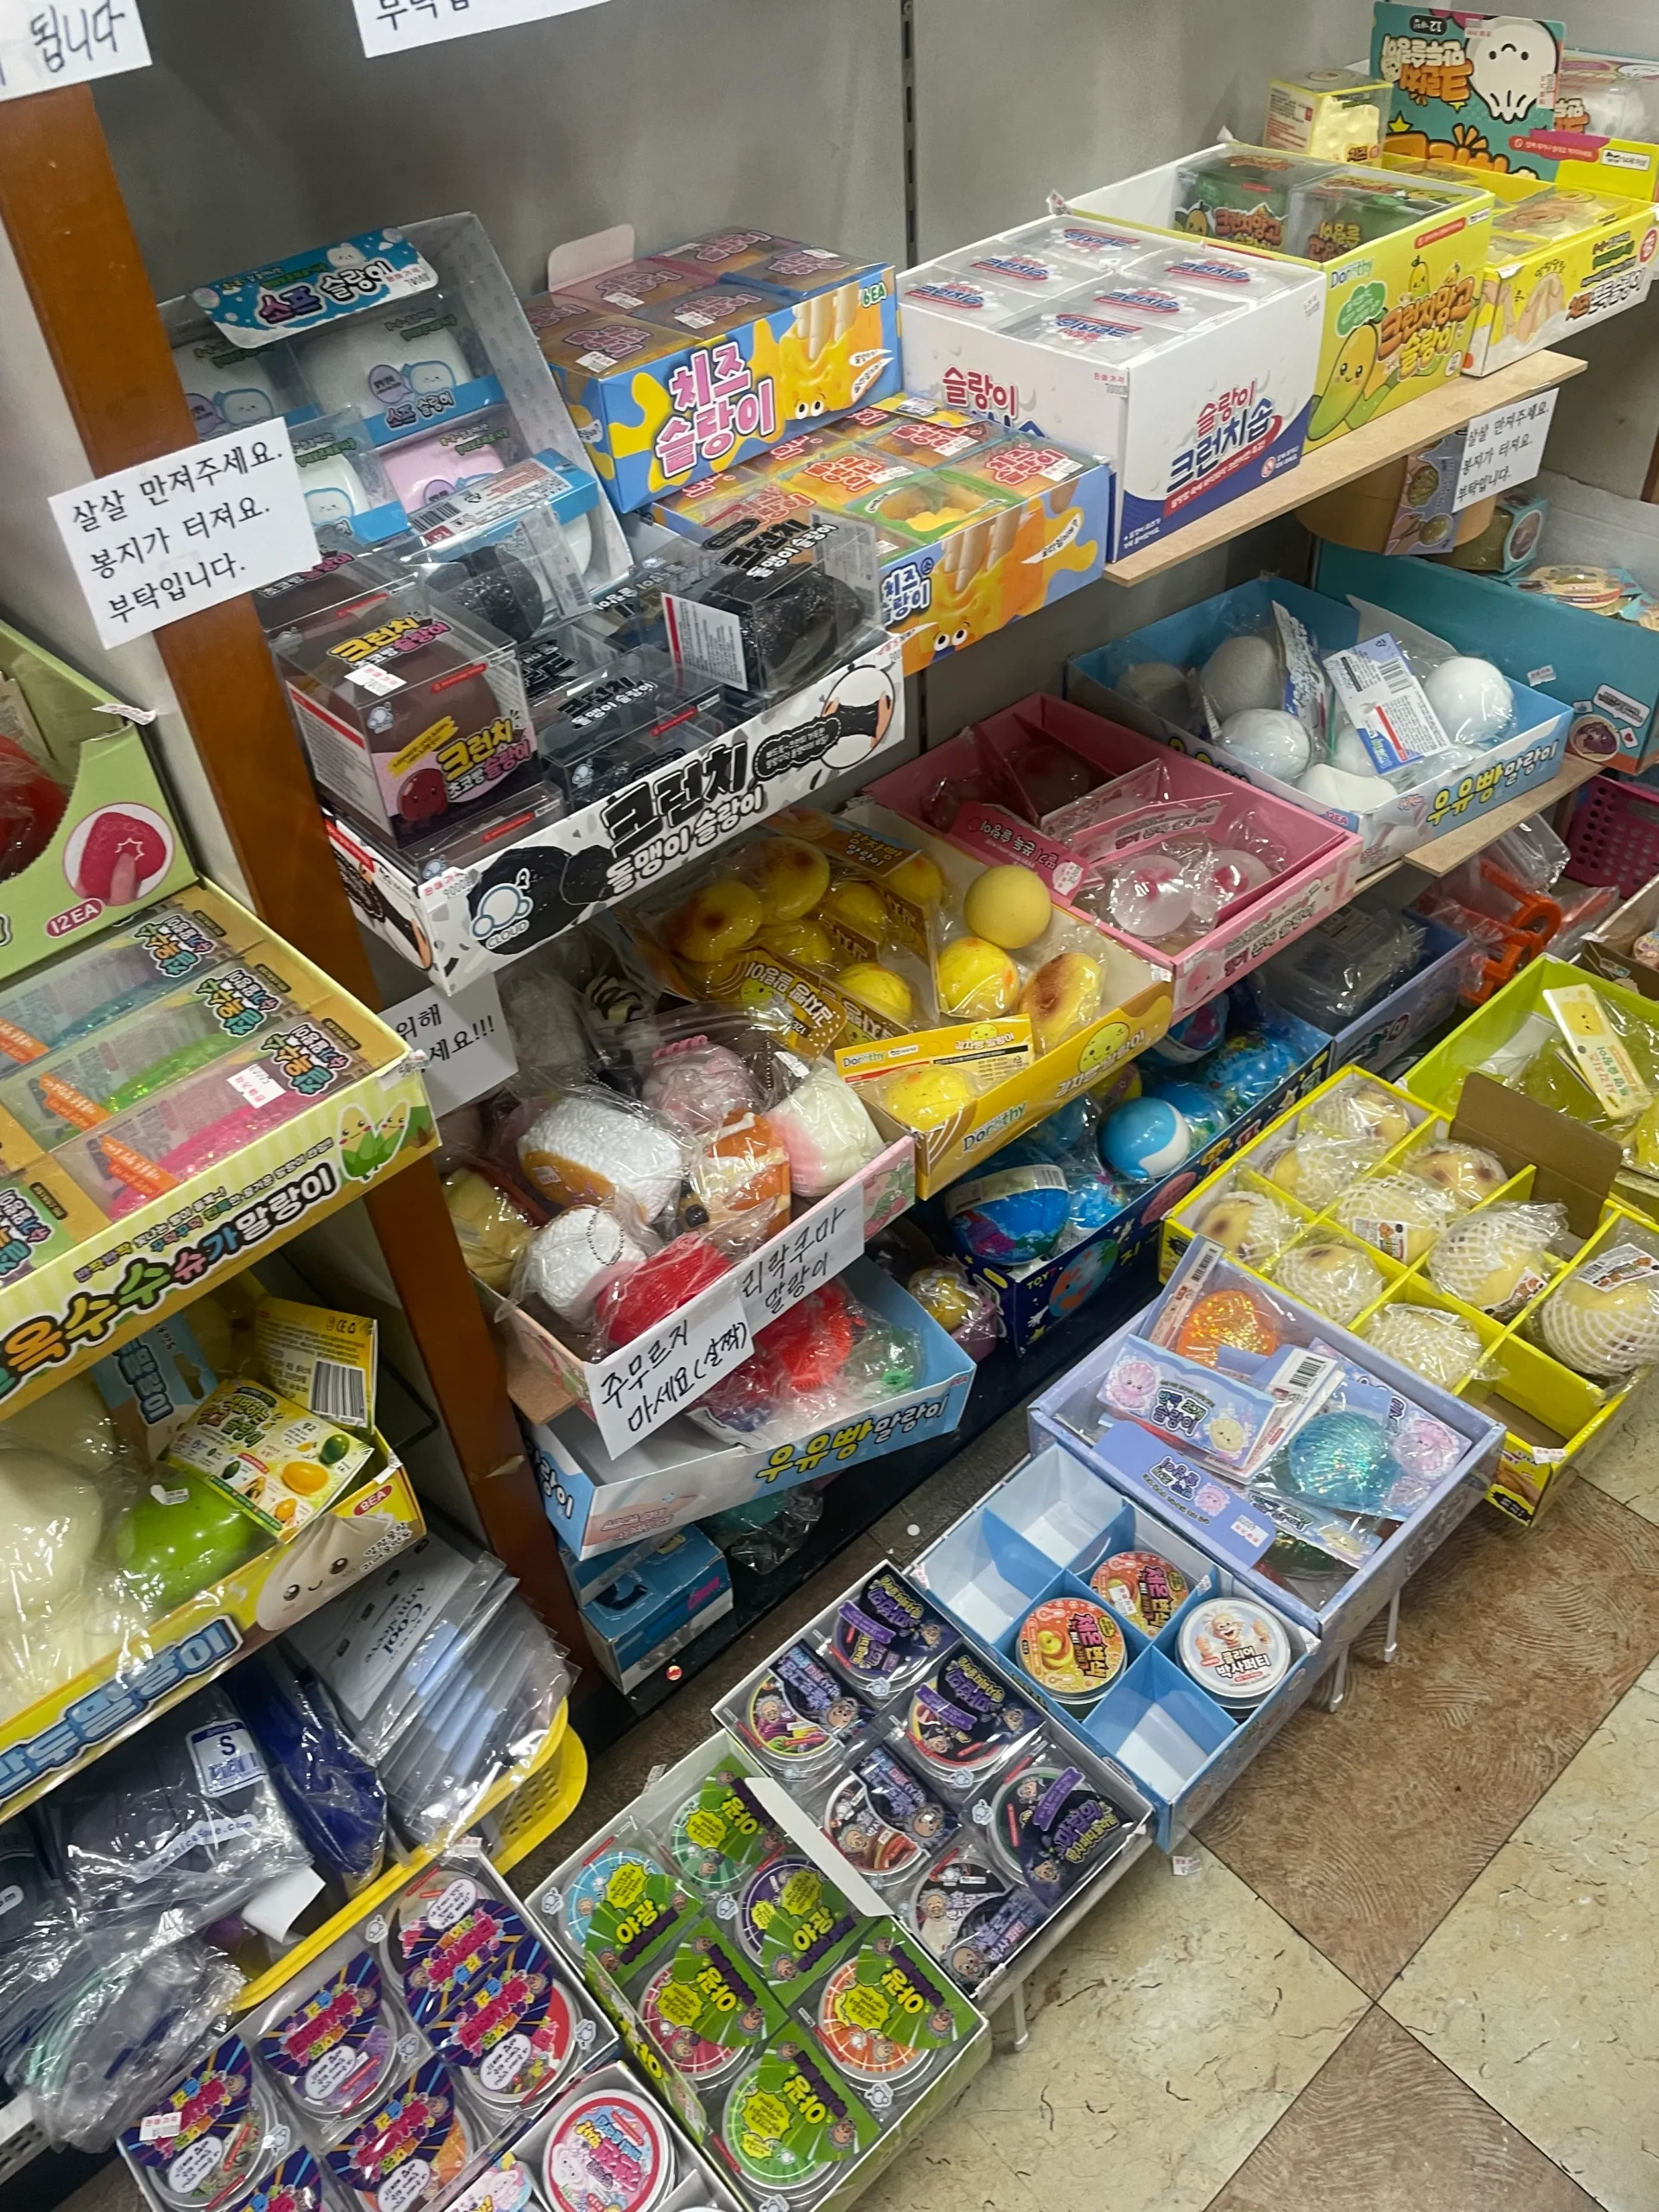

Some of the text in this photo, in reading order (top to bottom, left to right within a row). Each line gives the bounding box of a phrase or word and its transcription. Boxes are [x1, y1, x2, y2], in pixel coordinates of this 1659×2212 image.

[30, 1, 125, 73] 됩니다
[259, 282, 325, 324] 소프
[321, 257, 391, 300] 슬랑이
[1378, 276, 1476, 361] 크런치망고
[669, 341, 750, 410] 치즈
[1399, 325, 1455, 380] 슬랑이
[943, 365, 1019, 418] 슬랑이
[1197, 378, 1258, 439] 슬랑이
[654, 379, 776, 478] 슬랑이
[73, 489, 125, 532] 살살
[140, 441, 283, 507] 만져주세요.
[1458, 466, 1510, 502] 부탁입니다.
[90, 496, 270, 580] 봉지가 터져요.
[717, 518, 810, 571] 크런치
[791, 524, 839, 549] 슬랑이
[108, 552, 245, 624] 부탁입니다.
[882, 563, 919, 598] 치즈
[328, 617, 420, 663] 크런치
[393, 622, 452, 652] 슬랑이
[556, 677, 637, 716] 크런치
[614, 681, 654, 705] 슬랑이
[436, 718, 514, 781] 크런치
[448, 769, 486, 800] 초코빵
[483, 740, 531, 779] 슬랑이
[601, 740, 747, 860] 크런치
[1428, 761, 1504, 827] 우유빵
[1503, 740, 1558, 786] 말랑이
[605, 785, 765, 895] 돌맹이 슬랑이
[978, 817, 1014, 841] 슬랑이
[50, 902, 100, 933] 12EA
[486, 921, 528, 949] CLOUD
[196, 977, 264, 1036] 찰옥수수
[226, 968, 281, 1012] 슈가말랑이
[745, 958, 838, 1027] 말랑이 감자빵
[261, 1033, 334, 1096] 찰옥수수
[292, 1023, 351, 1071] 슈가말랑이
[842, 1048, 886, 1068] Dorothy
[984, 1033, 1015, 1049] 말랑이
[1055, 1028, 1146, 1098] 감자빵 말랑이
[962, 1102, 1028, 1154] Dorothy
[741, 1205, 849, 1299] 리락쿠마
[762, 1253, 832, 1315] 말랑이
[600, 1319, 690, 1409] 주무르지
[755, 1393, 950, 1484] 우유빵 말랑이
[1152, 1406, 1198, 1435] 슬랑이
[359, 1488, 389, 1512] 8EA
[383, 1603, 423, 1654] Cool
[1070, 1612, 1110, 1679] 체온 변색
[1214, 1653, 1272, 1679] 박사퍼티
[219, 1735, 237, 1757] S
[718, 1792, 760, 1836] 야광
[615, 1897, 659, 1946] 야광
[791, 1905, 836, 1952] 야광
[695, 1966, 736, 2012] 야광
[879, 1967, 925, 2014] 야광
[782, 2075, 828, 2125] 야광
